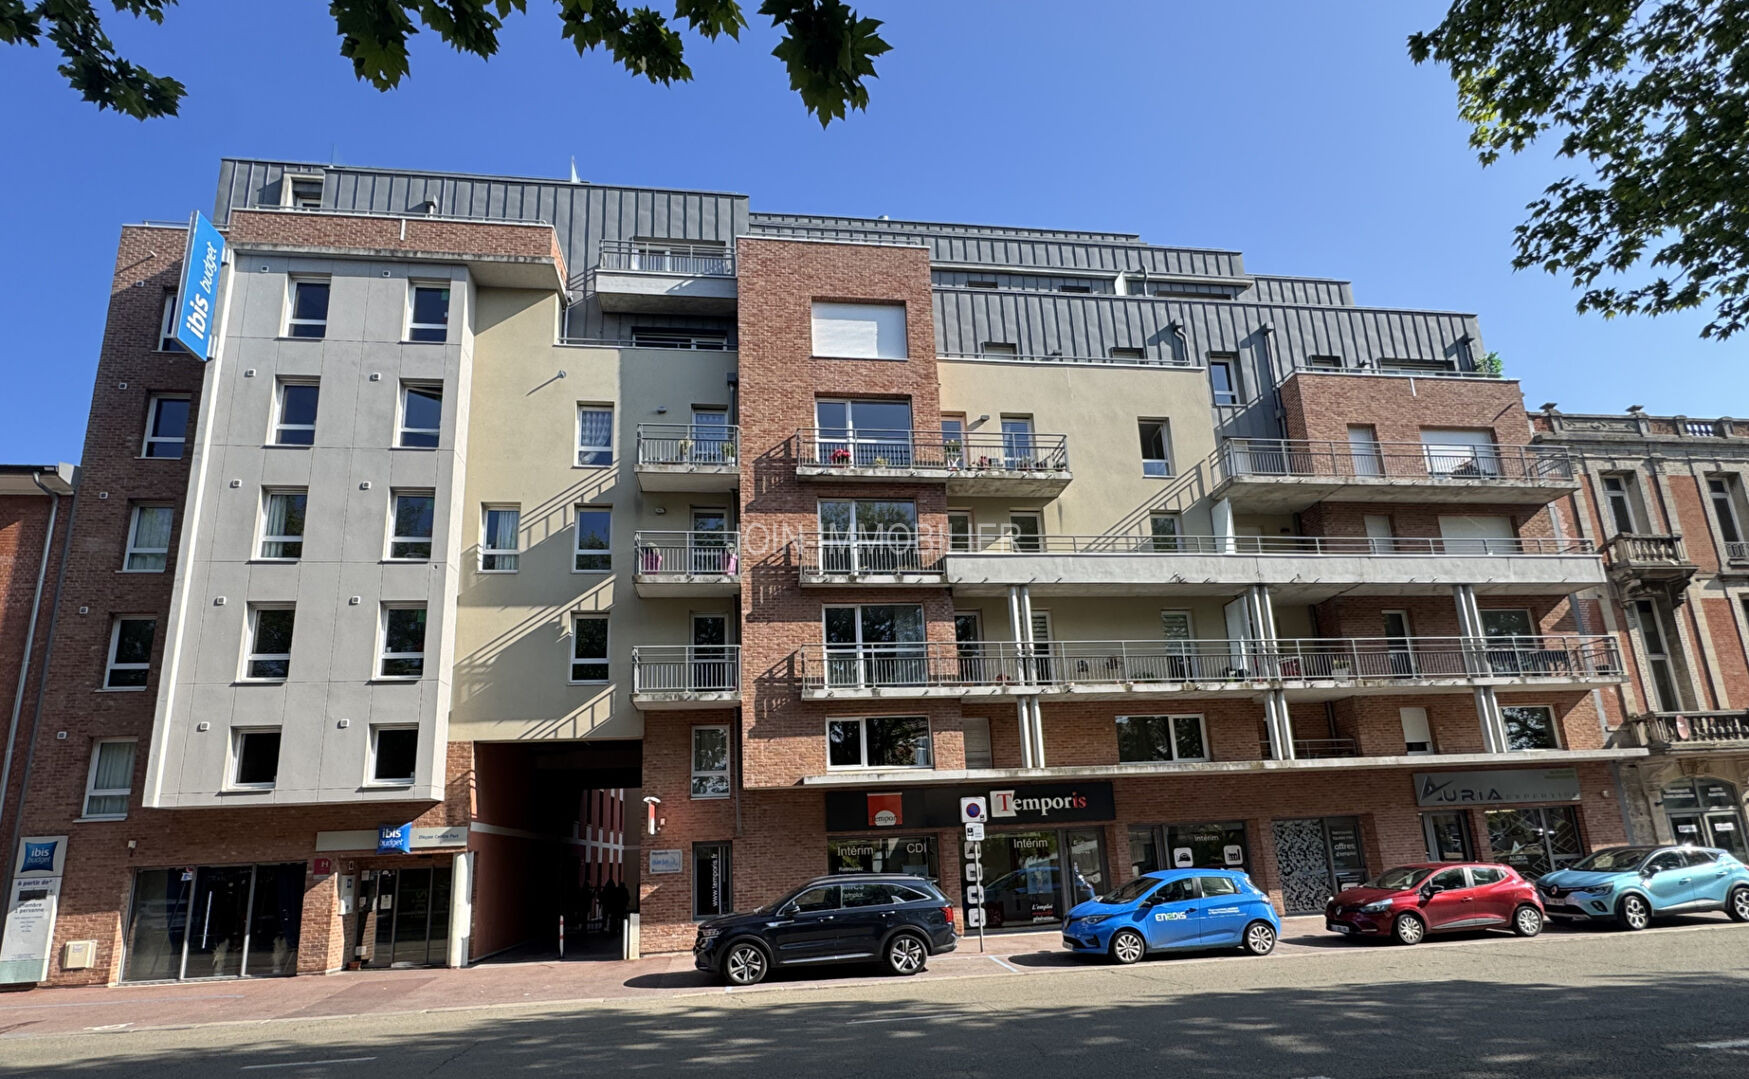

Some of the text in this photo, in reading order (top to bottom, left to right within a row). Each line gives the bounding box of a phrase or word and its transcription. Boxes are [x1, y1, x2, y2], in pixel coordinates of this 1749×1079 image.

[185, 241, 217, 341] ibis budget
[996, 791, 1088, 817] Temporis
[382, 827, 402, 838] ibis
[1194, 833, 1220, 842] Intérim
[379, 838, 404, 848] budget
[906, 842, 927, 855] CDI
[1013, 838, 1048, 849] Intérim
[31, 847, 50, 858] ibis
[837, 845, 874, 857] Intérim
[27, 856, 51, 865] budget
